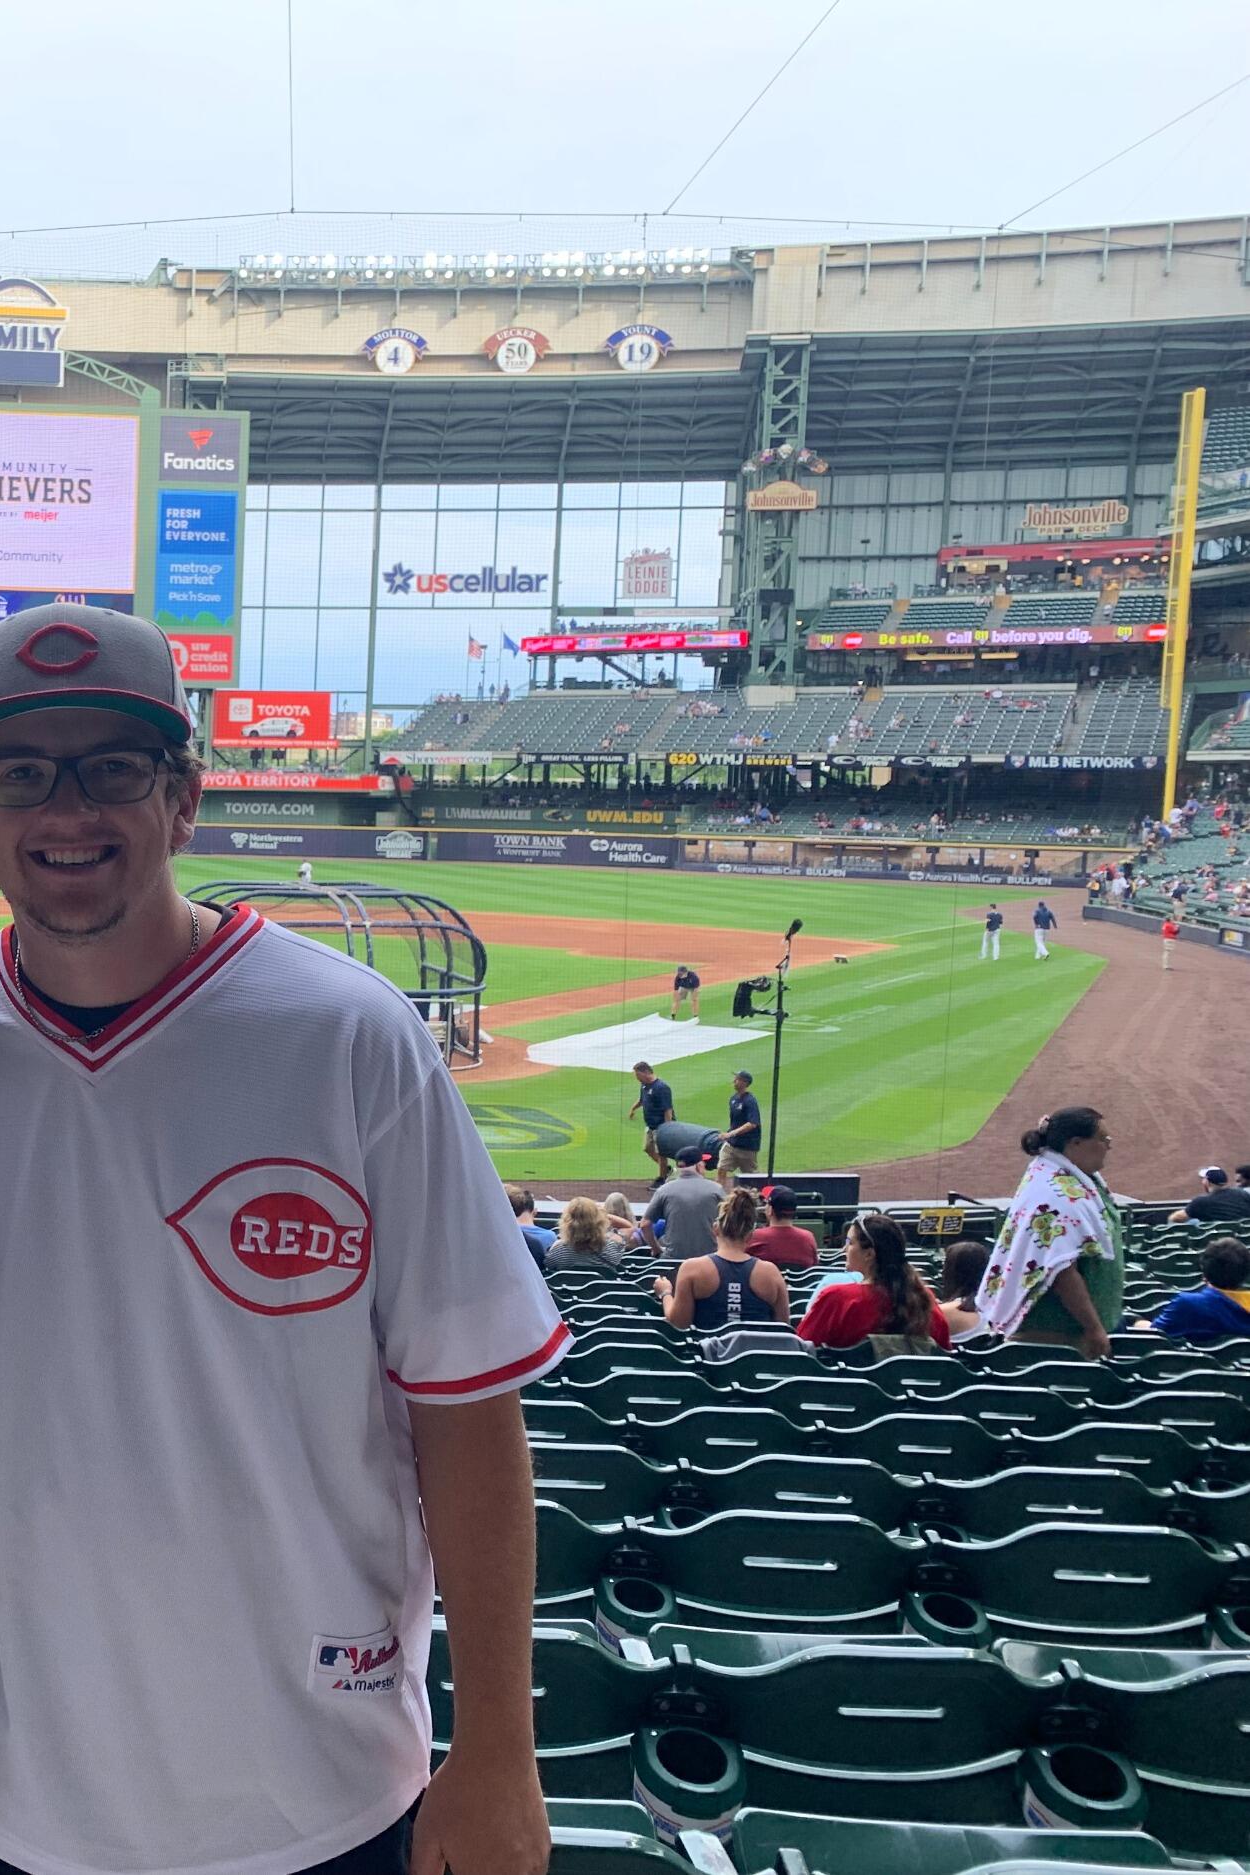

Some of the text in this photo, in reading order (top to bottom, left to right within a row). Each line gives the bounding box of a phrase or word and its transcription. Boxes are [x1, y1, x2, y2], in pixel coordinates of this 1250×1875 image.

[372, 330, 420, 344] MOLITOR
[496, 329, 536, 341] UECKER
[621, 327, 657, 338] YOUNT
[386, 346, 399, 365] 4
[505, 343, 528, 359] 50
[625, 341, 652, 363] 19
[164, 452, 235, 471] Fanatics
[751, 492, 814, 507] Johnsonville
[23, 509, 59, 522] meijer
[166, 508, 201, 519] FRESH
[1022, 500, 1126, 528] Johnsonville
[165, 520, 189, 529] FOR
[165, 531, 230, 542] EVERYONE.
[170, 562, 208, 574] metro
[628, 566, 668, 579] LEINIE
[170, 574, 214, 585] market
[628, 580, 668, 594] LODGE
[197, 592, 221, 602] Save
[878, 632, 933, 645] Be safe.
[946, 630, 972, 644] Call
[991, 630, 1036, 643] before
[1037, 631, 1064, 645] you
[1065, 627, 1092, 644] dig.
[190, 651, 228, 662] credit
[190, 663, 228, 673] union
[257, 704, 310, 717] TOYOTA
[668, 753, 744, 765] 620 WTMJ
[1028, 756, 1135, 768] MLB NETWORK
[201, 774, 319, 787] OYOTA TERRITORY
[224, 802, 314, 816] TOYOTA.COM
[586, 809, 664, 823] UWM.EDU
[249, 832, 303, 843] Northwestern
[493, 834, 568, 848] TOWN BANK
[609, 842, 643, 852] Aurora
[609, 851, 666, 864] Health Care
[806, 868, 846, 878] BULLPEN
[1007, 876, 1052, 886] BULLPEN
[238, 1215, 366, 1265] REDS
[354, 1675, 395, 1692] Majestic
